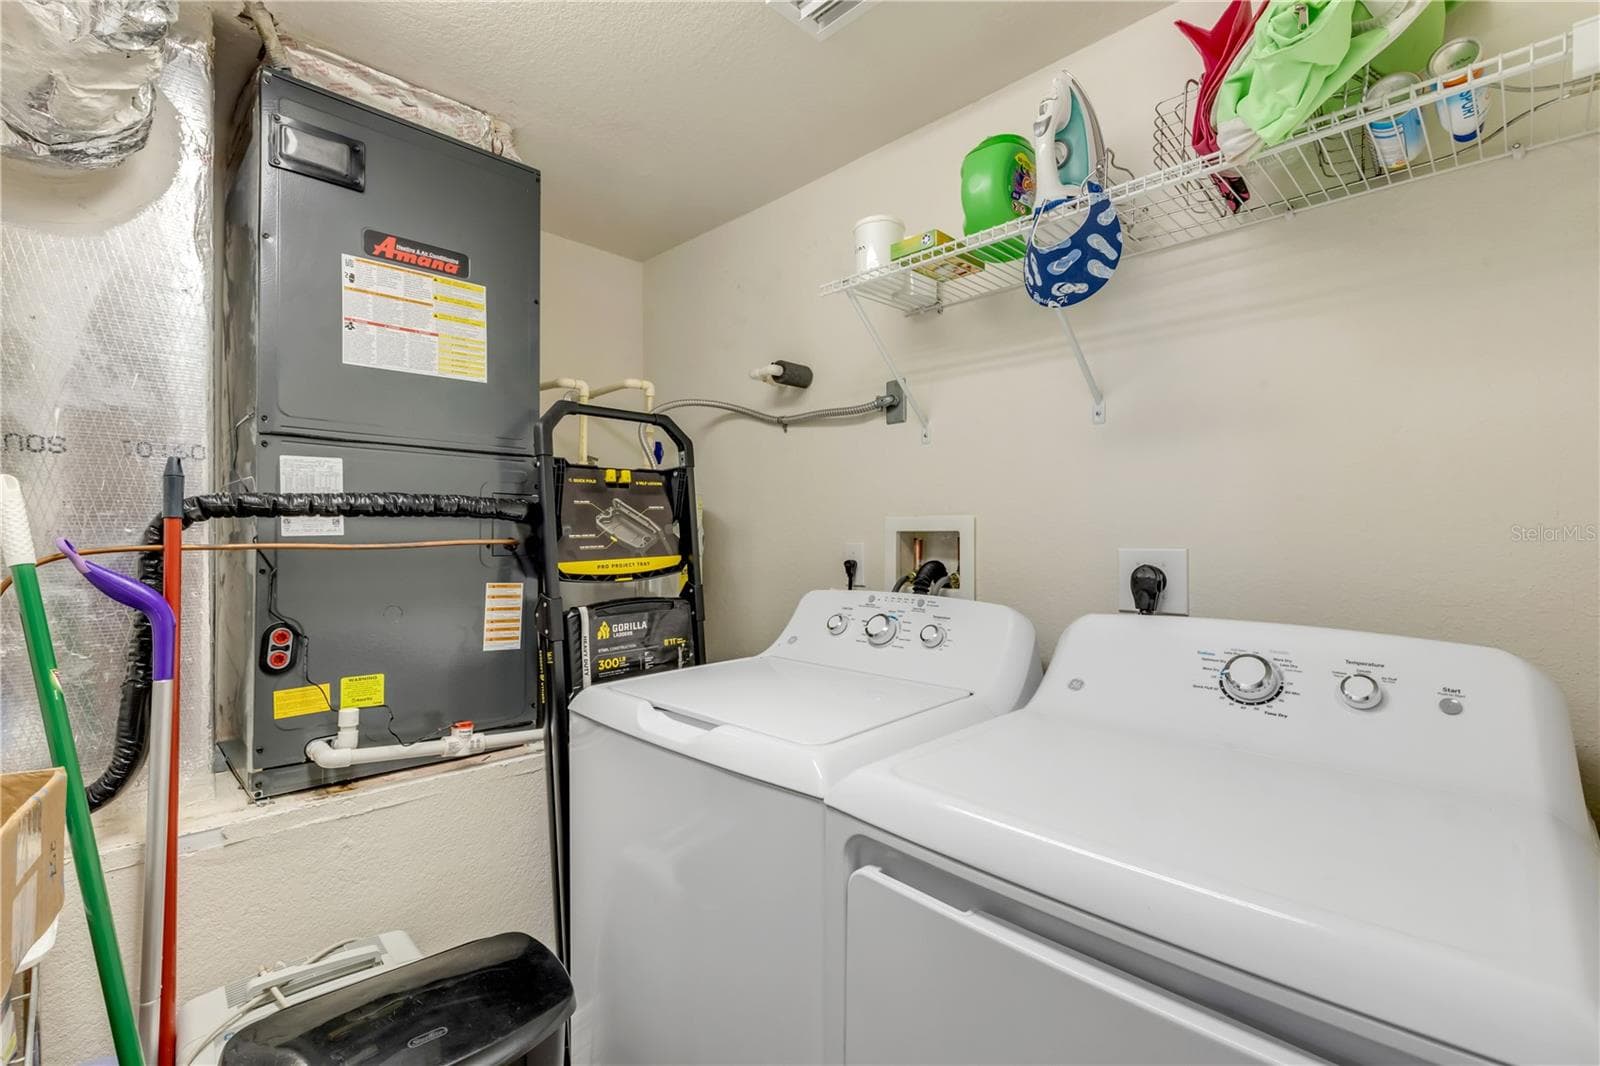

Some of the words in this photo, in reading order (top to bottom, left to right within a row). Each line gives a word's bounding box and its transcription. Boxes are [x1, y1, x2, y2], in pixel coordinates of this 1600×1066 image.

[372, 235, 460, 274] Amana
[612, 620, 648, 633] GORILLA
[598, 657, 619, 671] 300
[1345, 659, 1385, 668] Temperature
